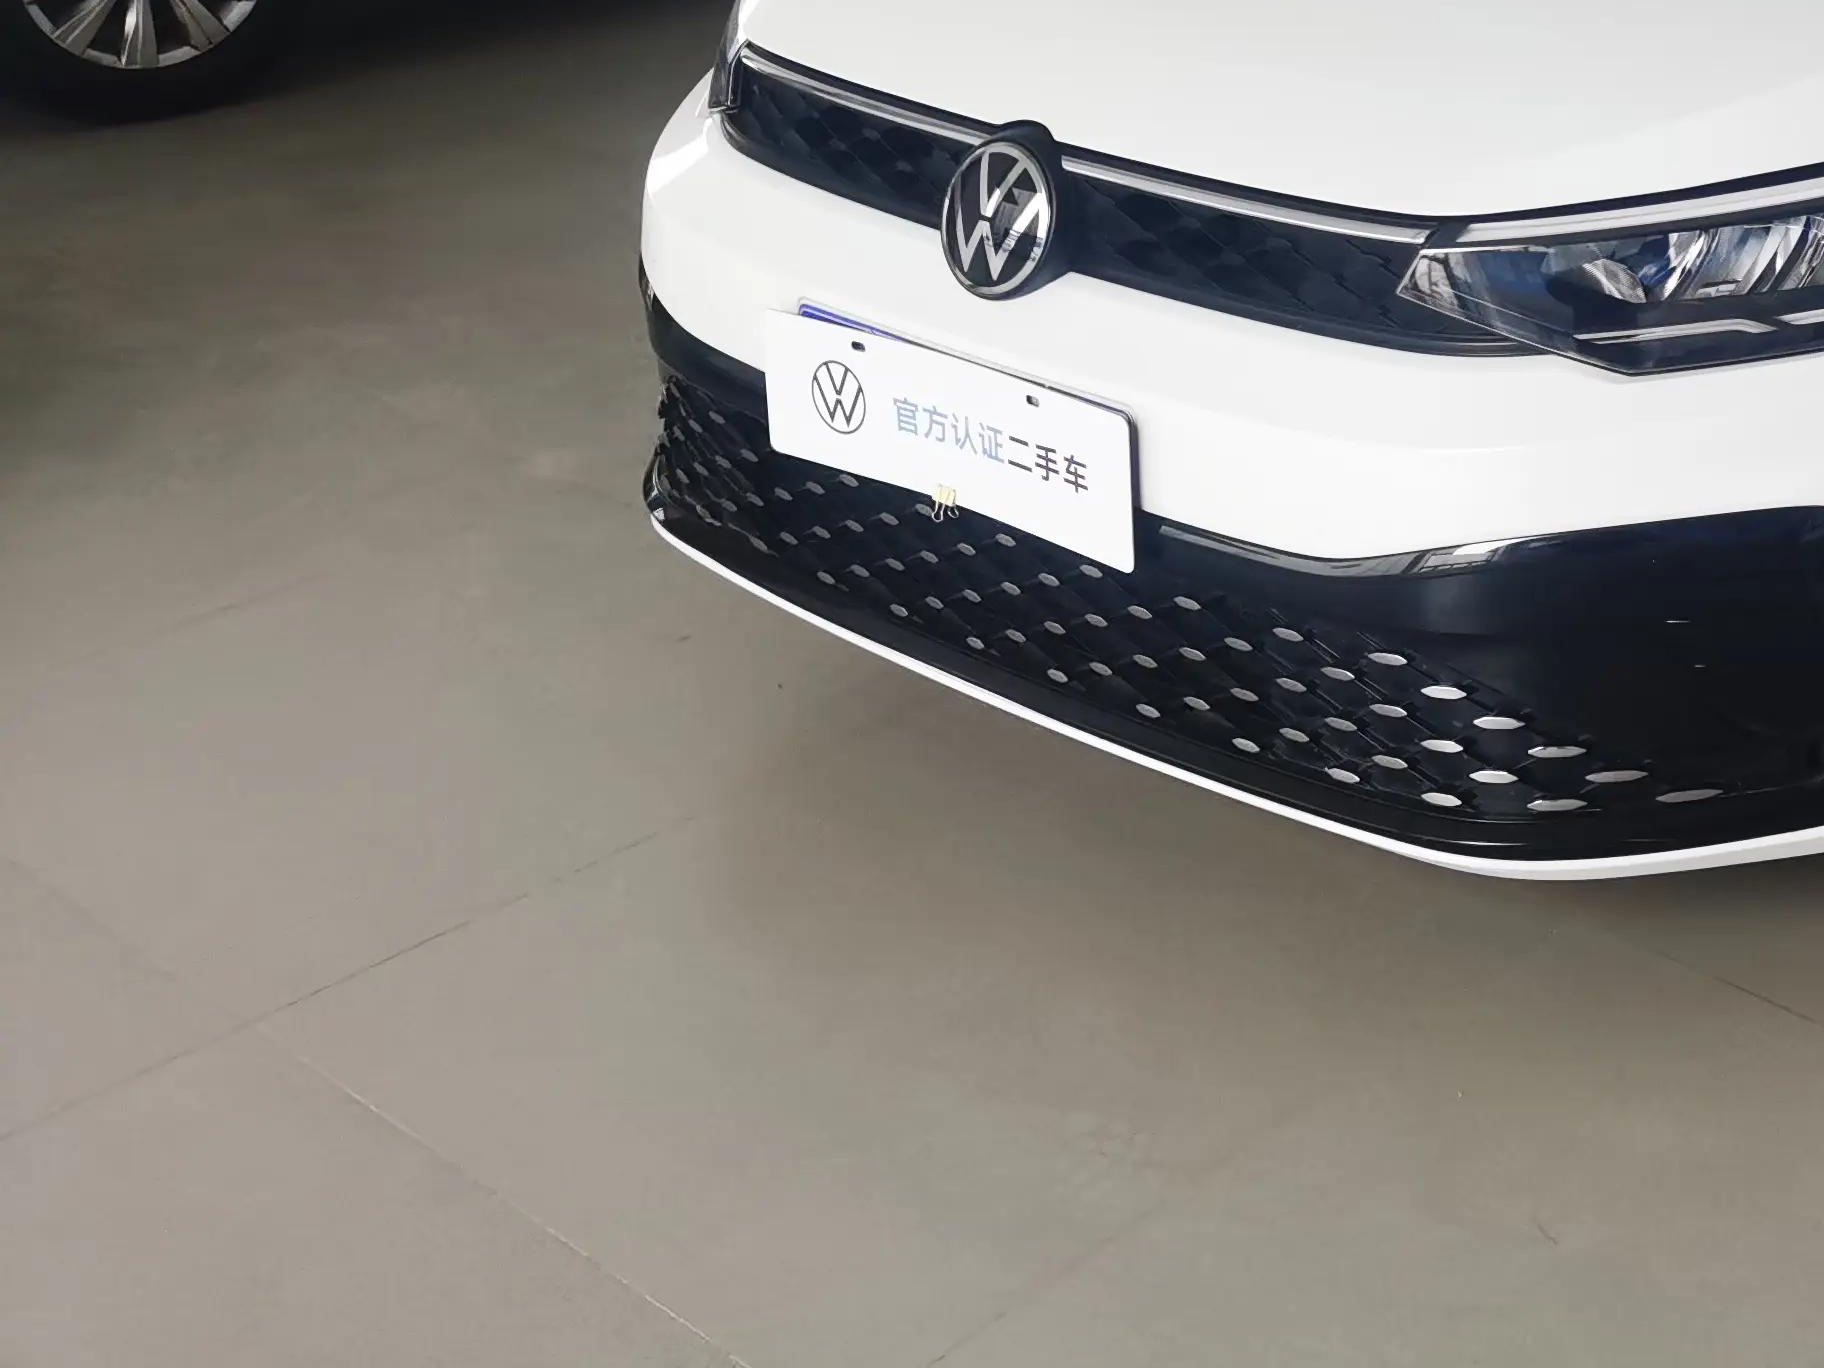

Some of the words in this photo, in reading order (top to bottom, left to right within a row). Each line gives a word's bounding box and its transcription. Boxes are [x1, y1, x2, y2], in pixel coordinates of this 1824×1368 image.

[892, 397, 1089, 493] 官方认证二手车
